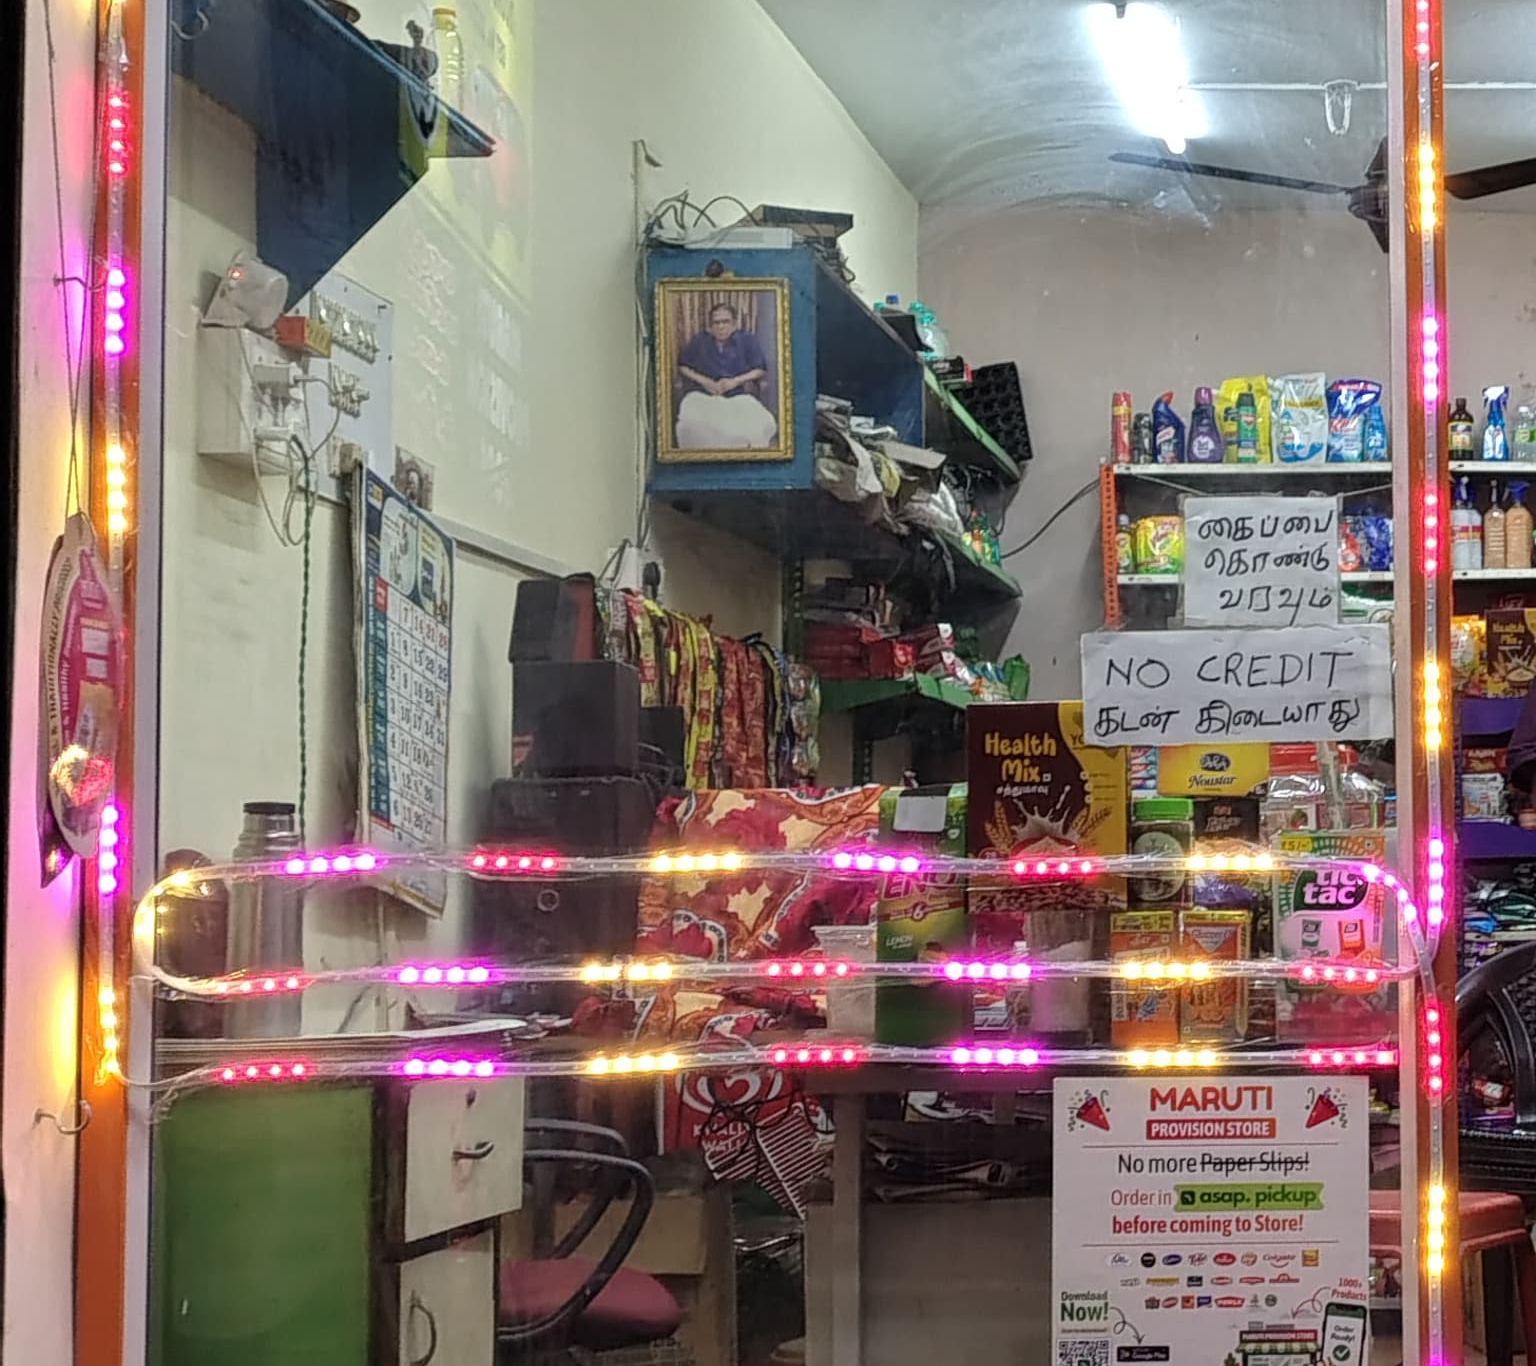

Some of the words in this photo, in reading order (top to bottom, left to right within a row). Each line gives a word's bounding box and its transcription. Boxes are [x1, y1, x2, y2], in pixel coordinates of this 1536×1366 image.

[1105, 657, 1171, 688] NO
[1196, 652, 1354, 688] CREDIT
[984, 732, 1057, 757] Health
[1001, 758, 1041, 783] Mix
[1303, 884, 1356, 905] tac
[1149, 1085, 1273, 1112] MARUTI
[1118, 1153, 1144, 1174] No
[1149, 1158, 1198, 1174] more
[1200, 1152, 1255, 1177] Paper
[1260, 1151, 1310, 1176] Slips!
[1111, 1189, 1155, 1206] Order
[1157, 1189, 1172, 1206] in
[1199, 1190, 1251, 1208] asap.
[1255, 1184, 1317, 1208] pickup
[1112, 1215, 1167, 1234] before
[1170, 1215, 1232, 1236] coming
[1235, 1216, 1251, 1232] to
[1255, 1214, 1304, 1232] Store!
[1061, 1291, 1108, 1301] Download
[1331, 1289, 1367, 1300] Products
[1060, 1302, 1109, 1322] Now!
